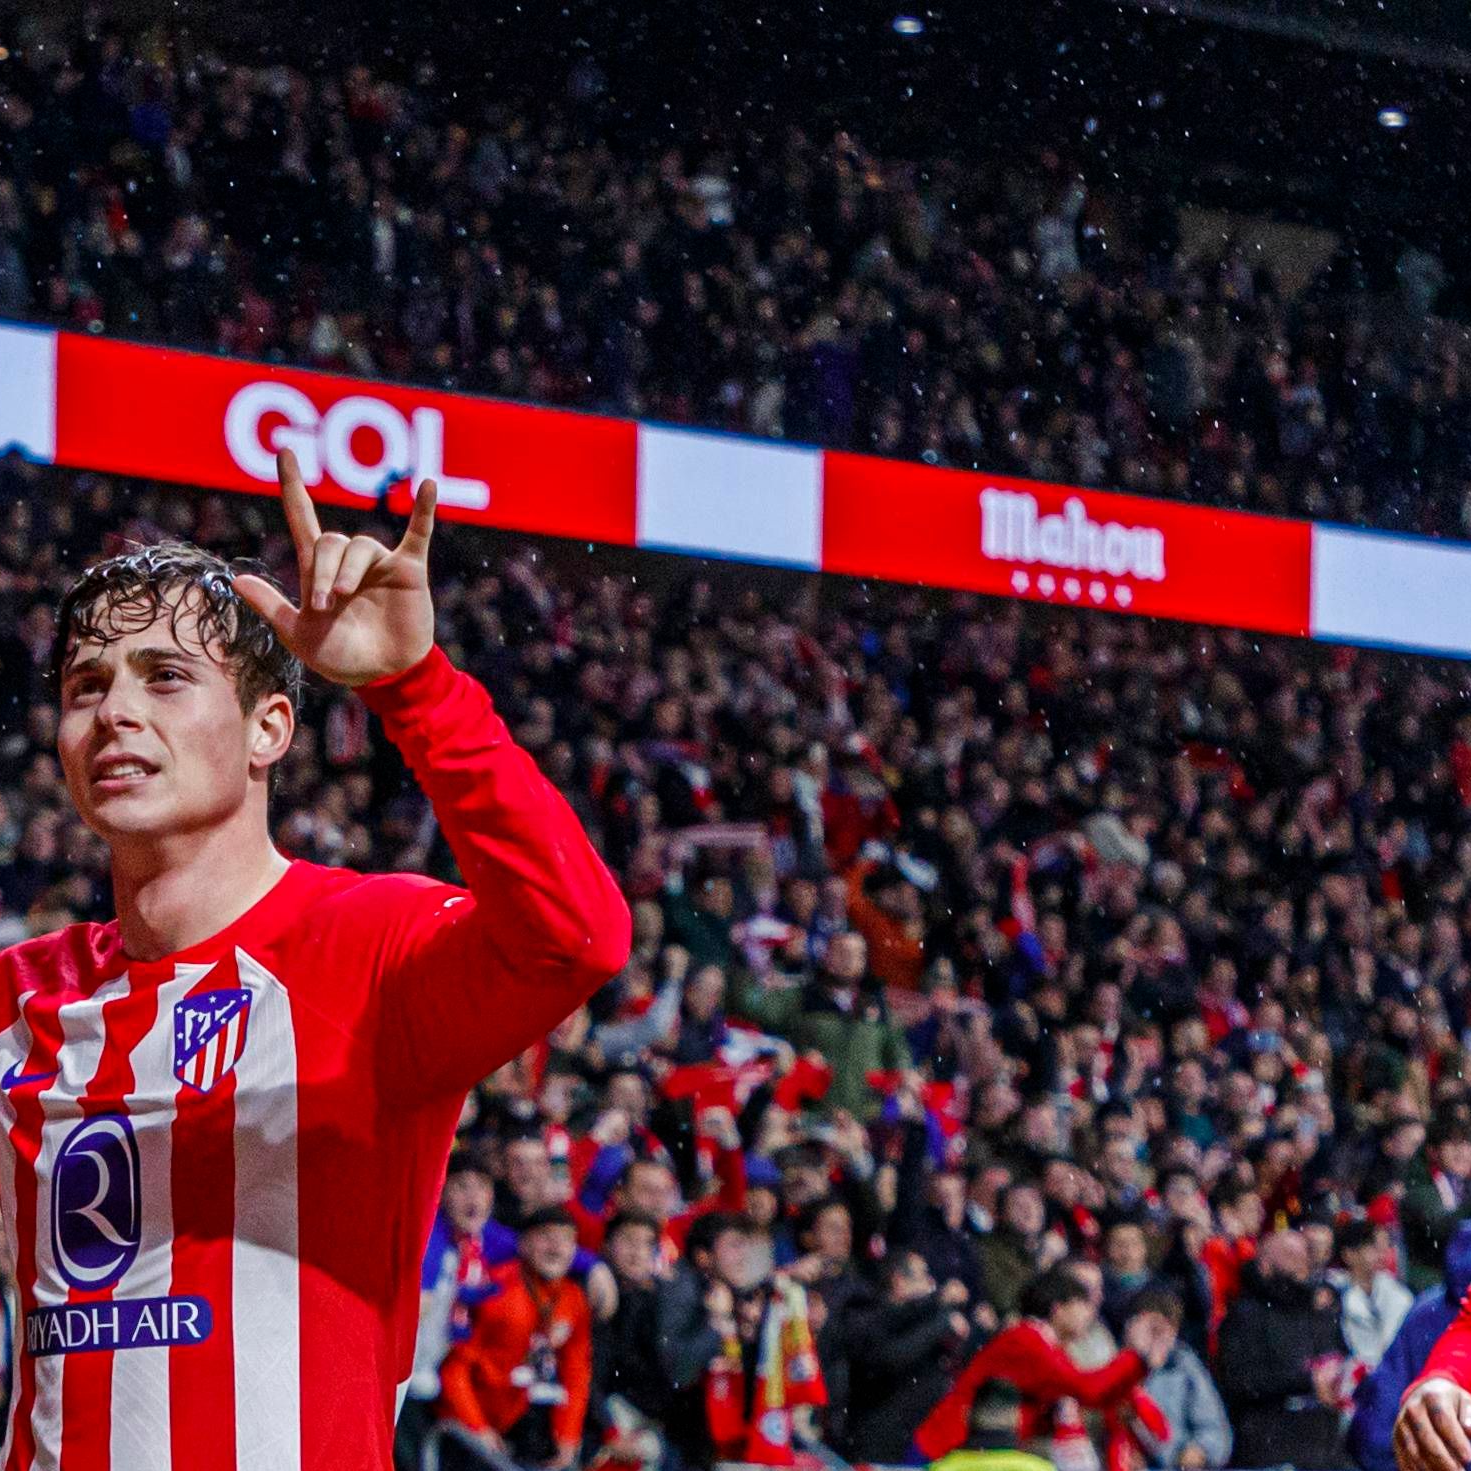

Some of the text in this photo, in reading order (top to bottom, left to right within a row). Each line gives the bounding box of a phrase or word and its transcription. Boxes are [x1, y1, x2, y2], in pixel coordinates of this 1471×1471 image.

[224, 381, 490, 511] GOL
[27, 1307, 119, 1352] RIYADH
[131, 1302, 201, 1342] AIR
